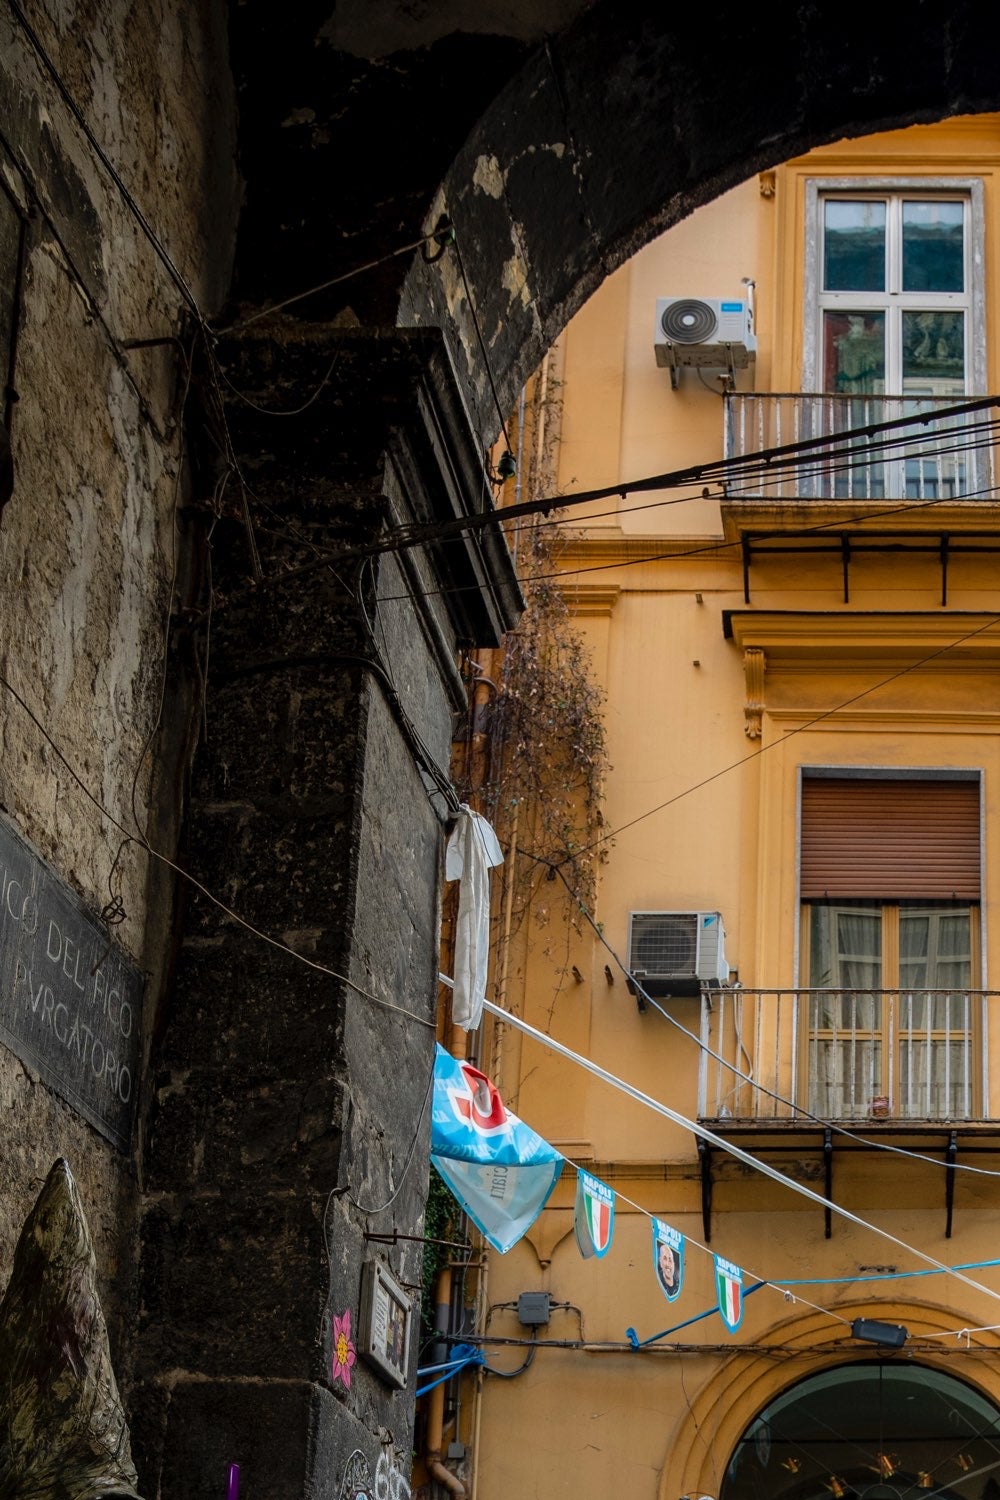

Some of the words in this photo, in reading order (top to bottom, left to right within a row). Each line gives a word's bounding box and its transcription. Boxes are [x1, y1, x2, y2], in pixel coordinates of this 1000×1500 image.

[0, 866, 38, 934] ICO
[47, 920, 84, 991] DEL
[584, 1174, 611, 1199] NAPOLI
[656, 1219, 682, 1242] NAPOLI
